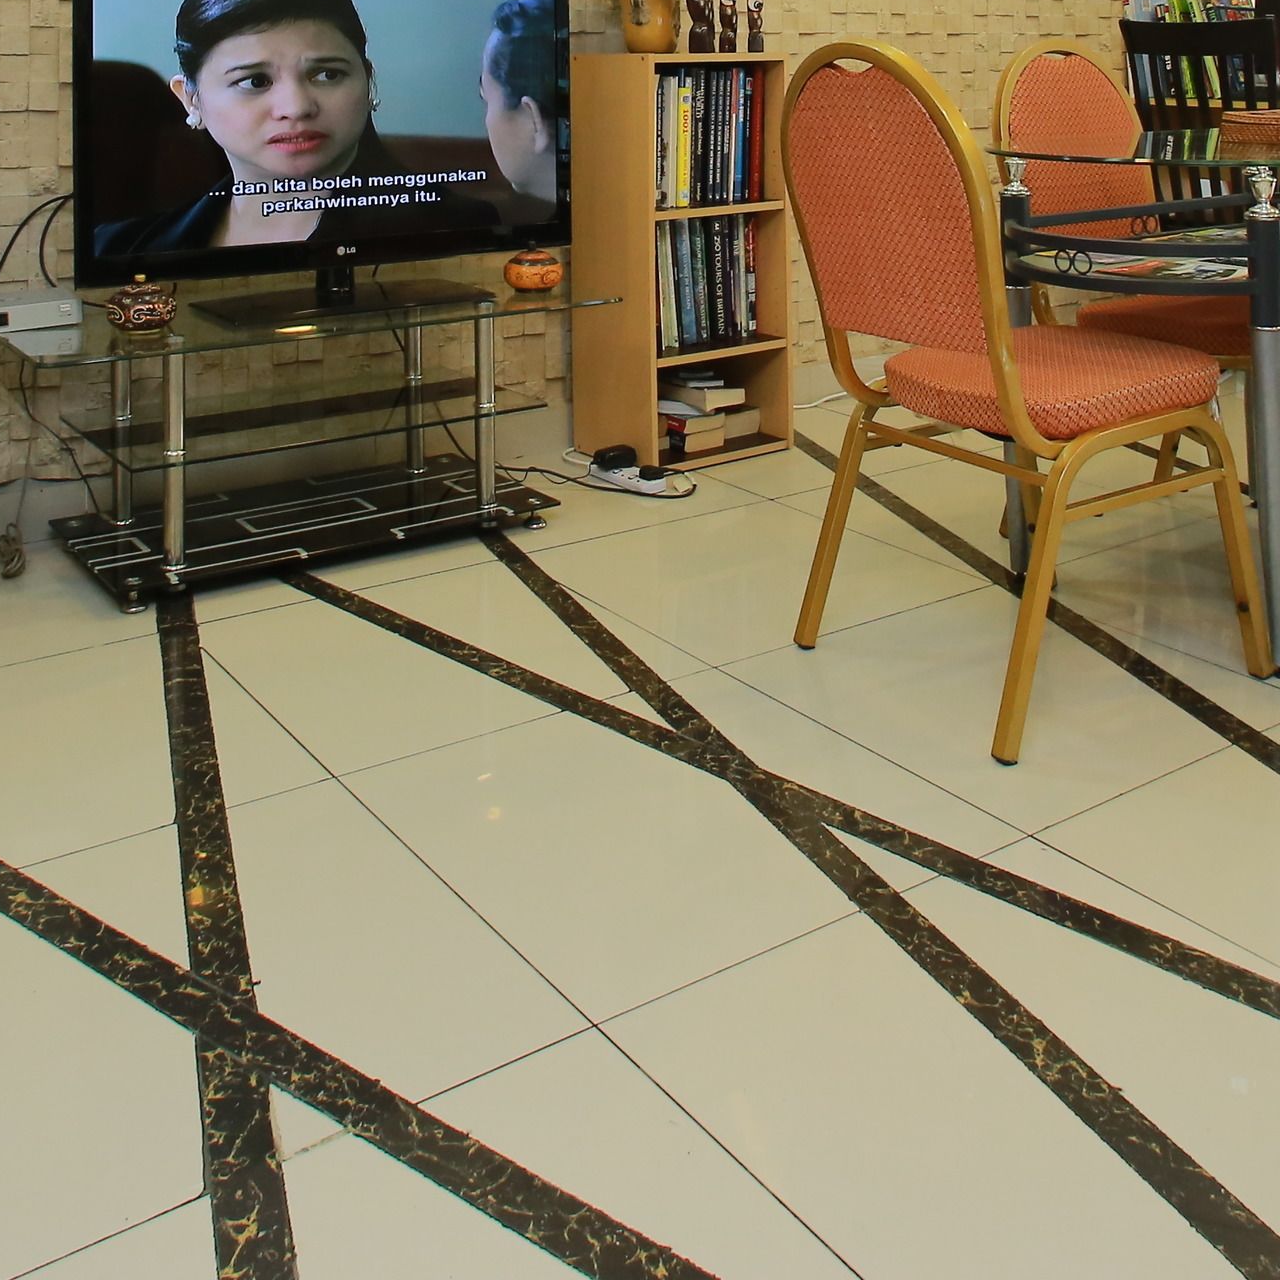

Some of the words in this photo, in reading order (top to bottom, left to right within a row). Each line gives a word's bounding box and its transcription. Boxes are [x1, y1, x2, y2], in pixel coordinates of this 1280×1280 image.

[232, 180, 267, 196] dan
[273, 178, 306, 193] kita
[312, 175, 363, 191] boleh
[368, 169, 487, 189] menggunakan
[262, 192, 410, 216] perkahwinannya
[415, 190, 441, 203] itu.
[346, 246, 356, 254] LG
[713, 235, 721, 252] 250
[714, 252, 722, 283] TOURS
[716, 284, 724, 297] OF
[716, 298, 725, 335] BRITAIN
